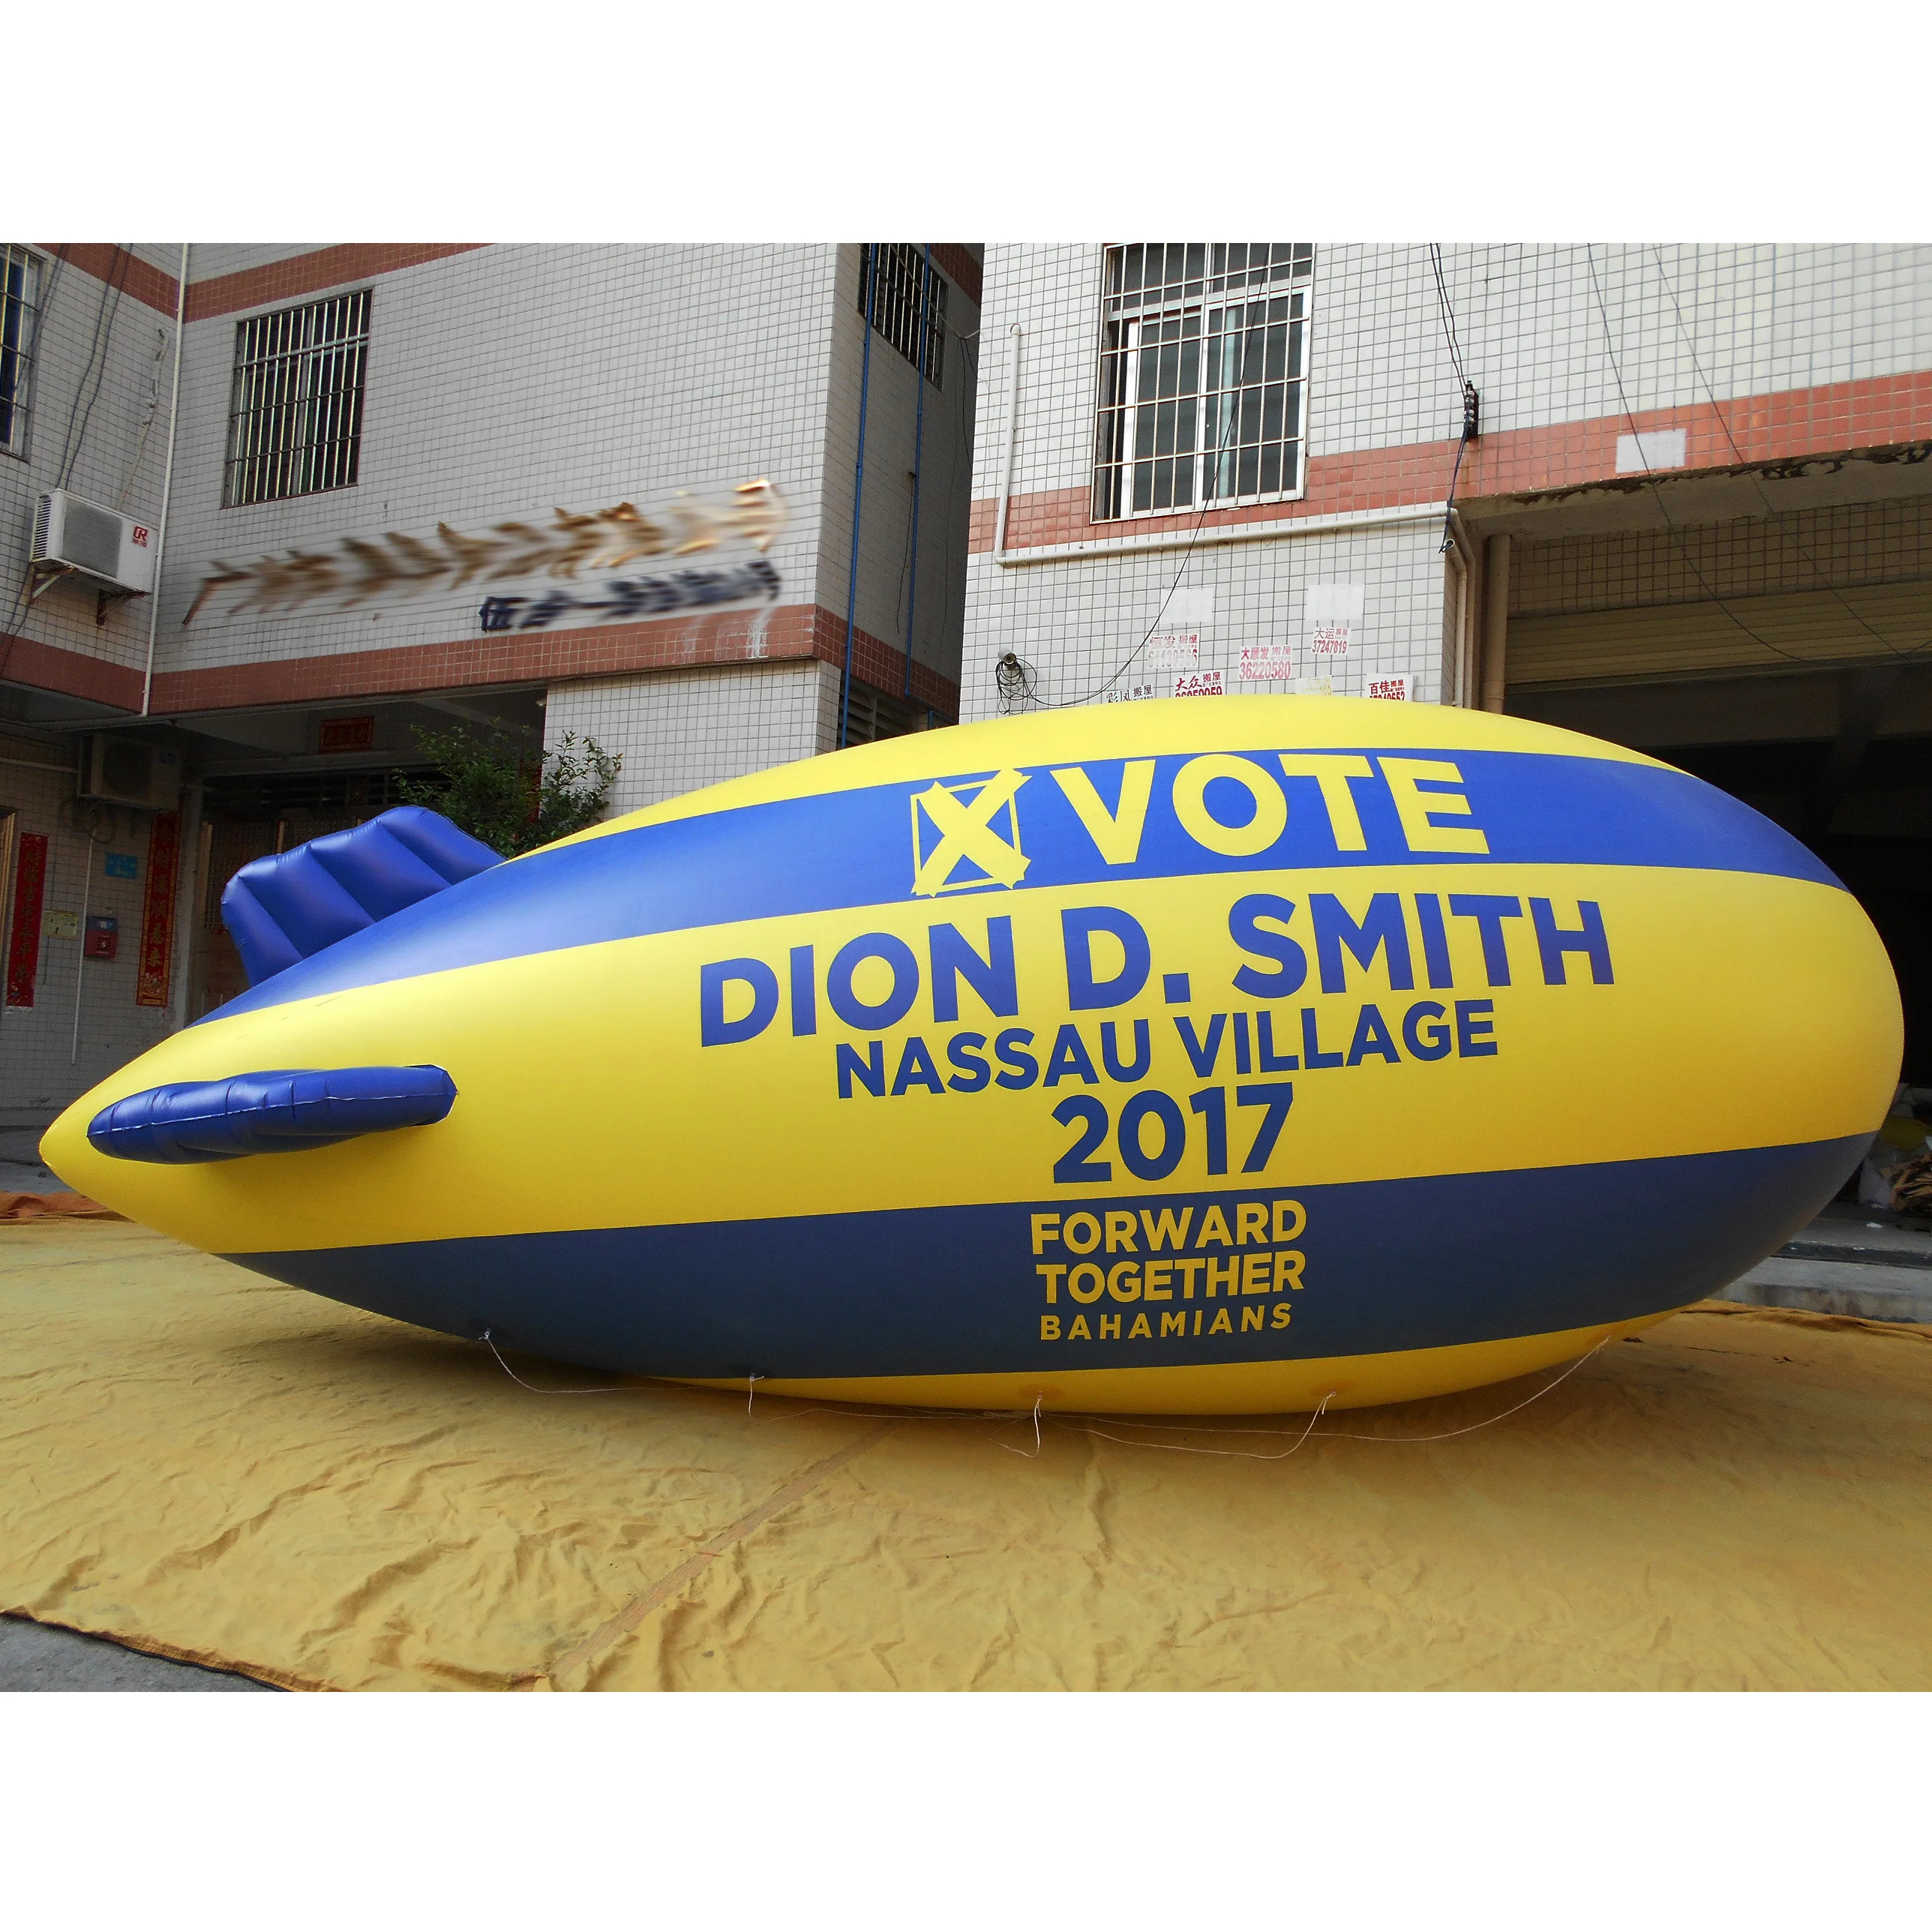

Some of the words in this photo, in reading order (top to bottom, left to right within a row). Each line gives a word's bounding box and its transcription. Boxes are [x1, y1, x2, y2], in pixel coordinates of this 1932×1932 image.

[1312, 640, 1348, 653] 37247819
[1314, 628, 1334, 639] 大运
[1175, 676, 1202, 692] 大众
[1203, 671, 1222, 682] 搬屋
[1239, 661, 1292, 680] 36220580
[1369, 680, 1390, 694] 百佳
[1133, 685, 1153, 697] 搬屋
[1051, 753, 1490, 866] VOTE
[700, 914, 1019, 1047] DION
[1060, 906, 1192, 1011] D.
[1228, 892, 1614, 999] SMITH
[836, 1019, 1152, 1098] NASSAU
[1173, 999, 1498, 1078] VILLAGE
[1052, 1082, 1294, 1184] 2017
[1031, 1199, 1308, 1256] FORWARD
[1036, 1250, 1307, 1304] TOGETHER
[1040, 1302, 1292, 1341] BAHAMIANS
